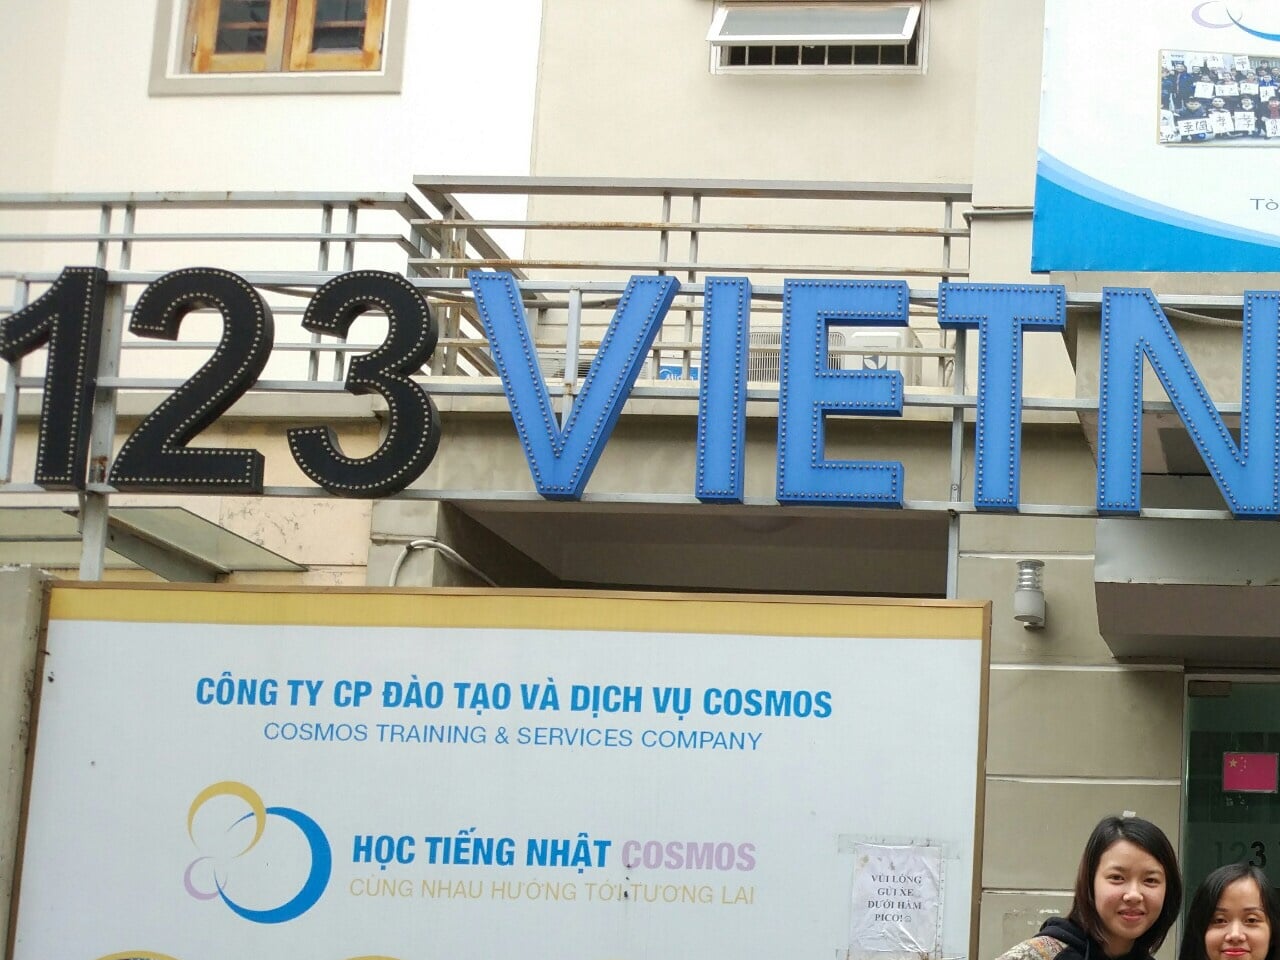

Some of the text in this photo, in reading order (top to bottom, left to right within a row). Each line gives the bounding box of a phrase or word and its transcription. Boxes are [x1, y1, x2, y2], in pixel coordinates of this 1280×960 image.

[0, 270, 441, 500] 123
[196, 672, 833, 721] CÔNG TY CP ĐÀO TẠO VÀ DỊCH VỤ COSMOS
[263, 722, 763, 751] COSMOS TRAINING & SERVICES COMPANY
[352, 827, 757, 874] HỌC TIẾNG NHẬT COSMOS
[421, 879, 484, 899] NHAU
[721, 885, 755, 905] LAI
